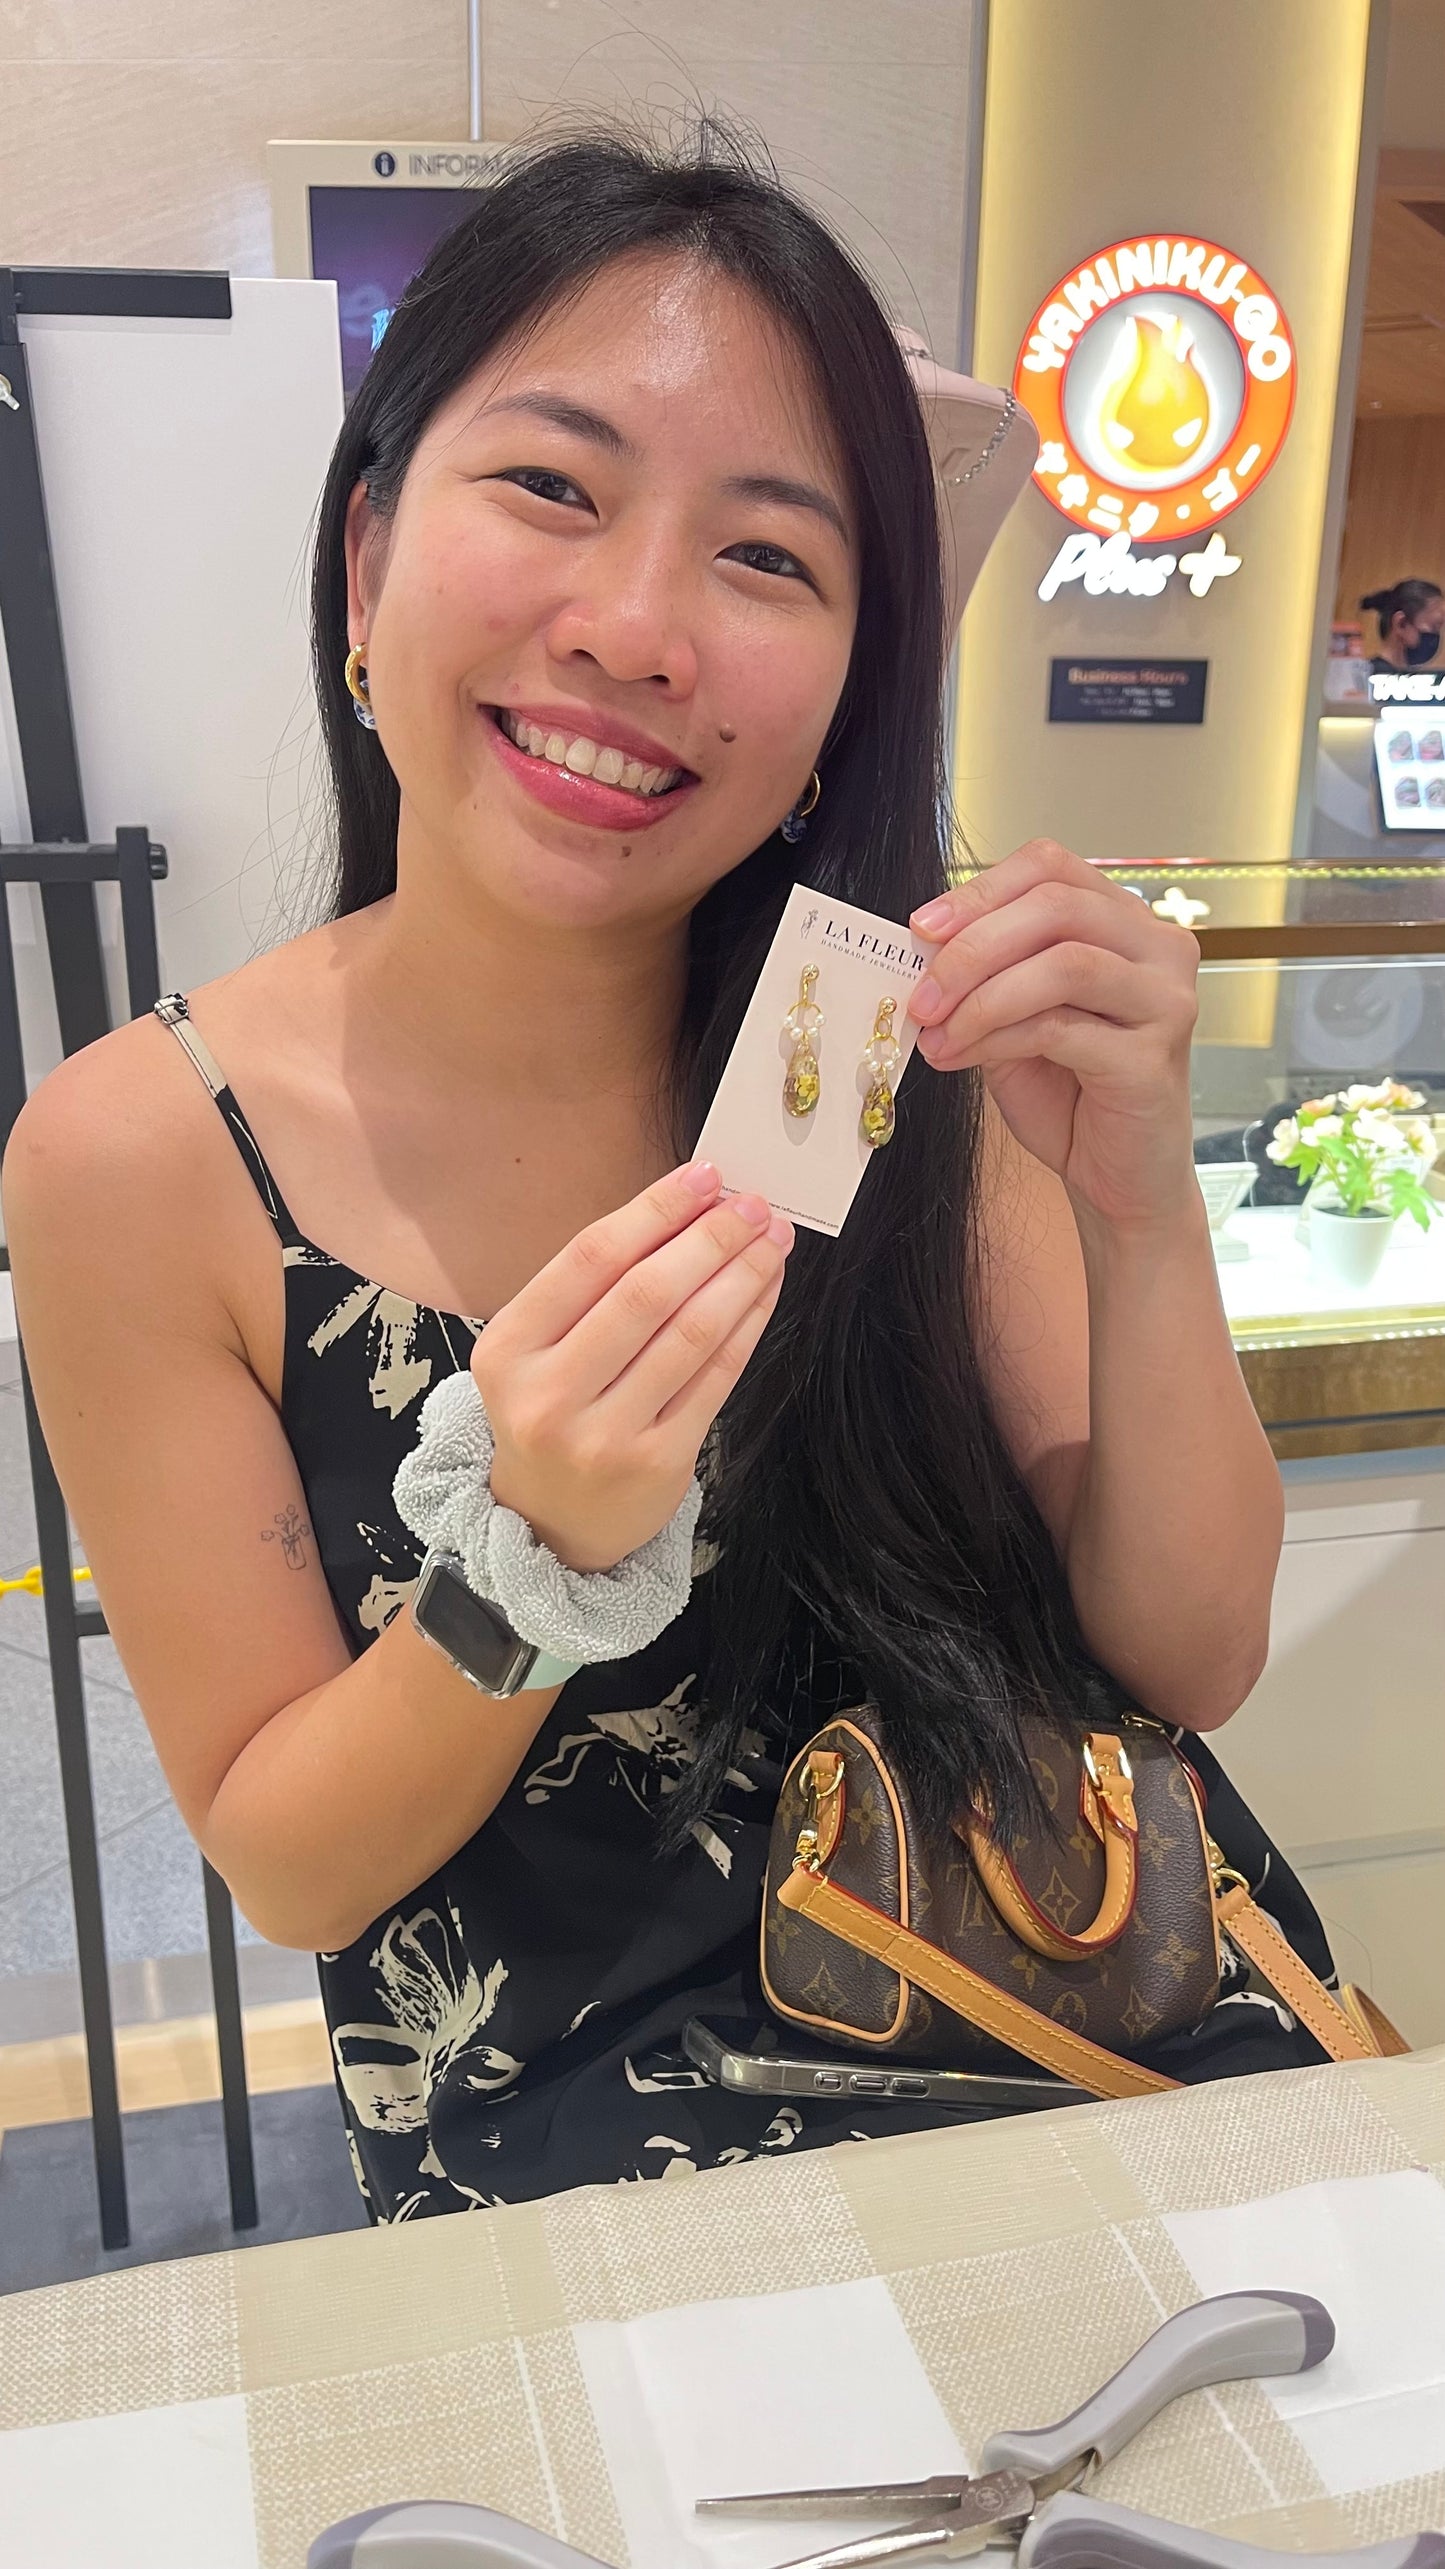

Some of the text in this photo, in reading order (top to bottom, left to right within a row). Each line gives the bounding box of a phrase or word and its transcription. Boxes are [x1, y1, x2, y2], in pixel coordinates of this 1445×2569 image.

[1023, 240, 1291, 382] YAKINIKU-GO
[820, 939, 918, 981] HANDMADE JEWELLERY
[825, 920, 924, 972] LA FLEUR
